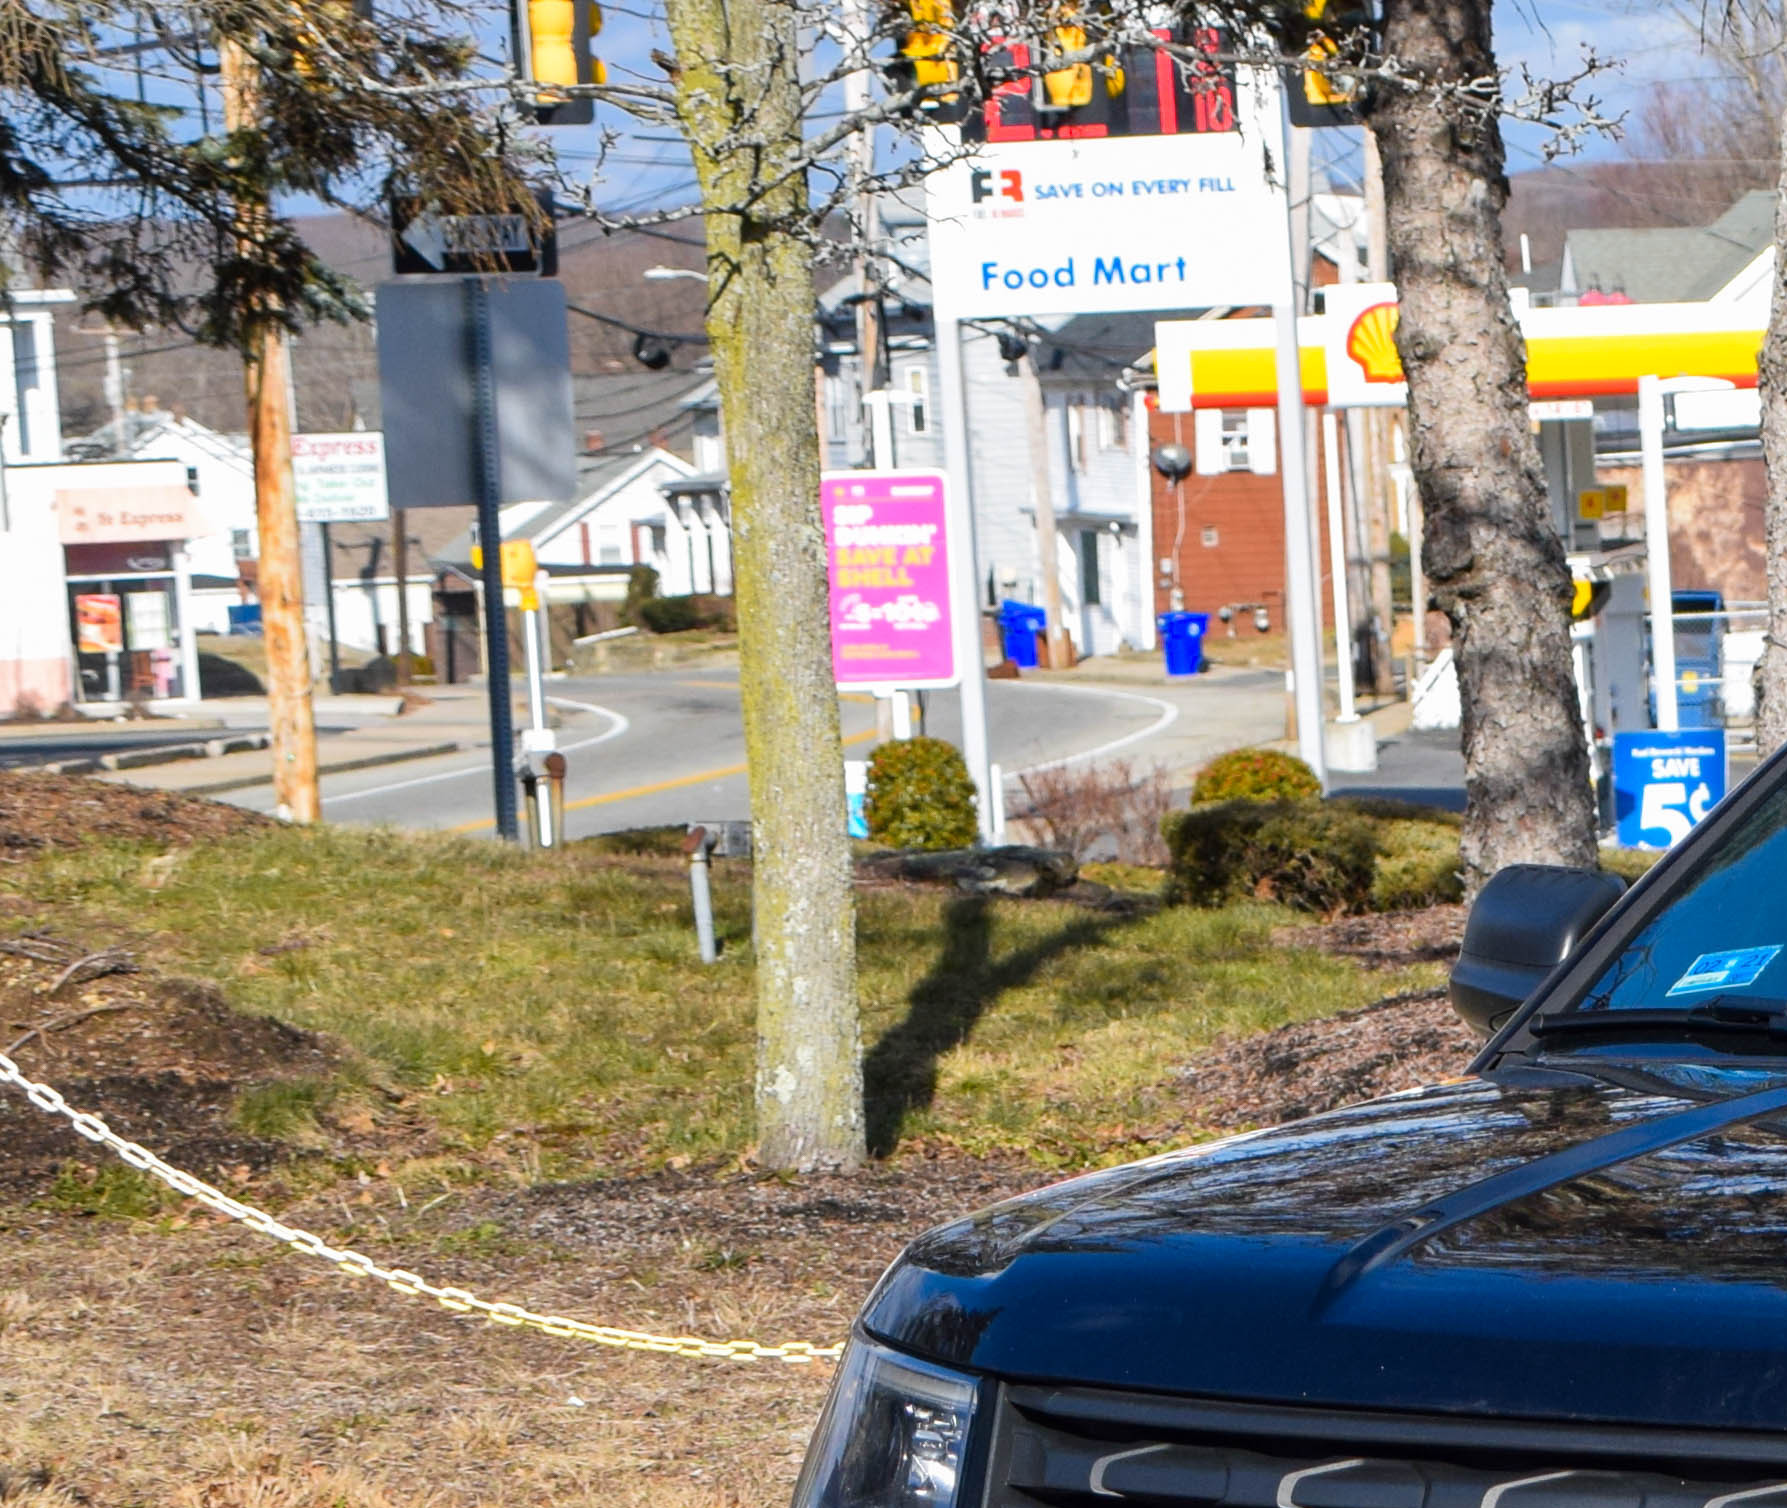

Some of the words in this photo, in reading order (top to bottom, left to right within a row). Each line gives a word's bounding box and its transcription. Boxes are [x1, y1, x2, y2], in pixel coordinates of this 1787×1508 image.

[1034, 183, 1084, 200] SAVE
[1092, 182, 1124, 197] ON
[1132, 178, 1192, 196] EVERY
[1199, 177, 1235, 193] FILL
[981, 257, 1076, 290] Food
[1093, 256, 1186, 286] Mart
[836, 547, 898, 567] SAVE
[903, 546, 935, 566] AT
[837, 568, 915, 588] SHELL
[1651, 757, 1702, 778] SAVE
